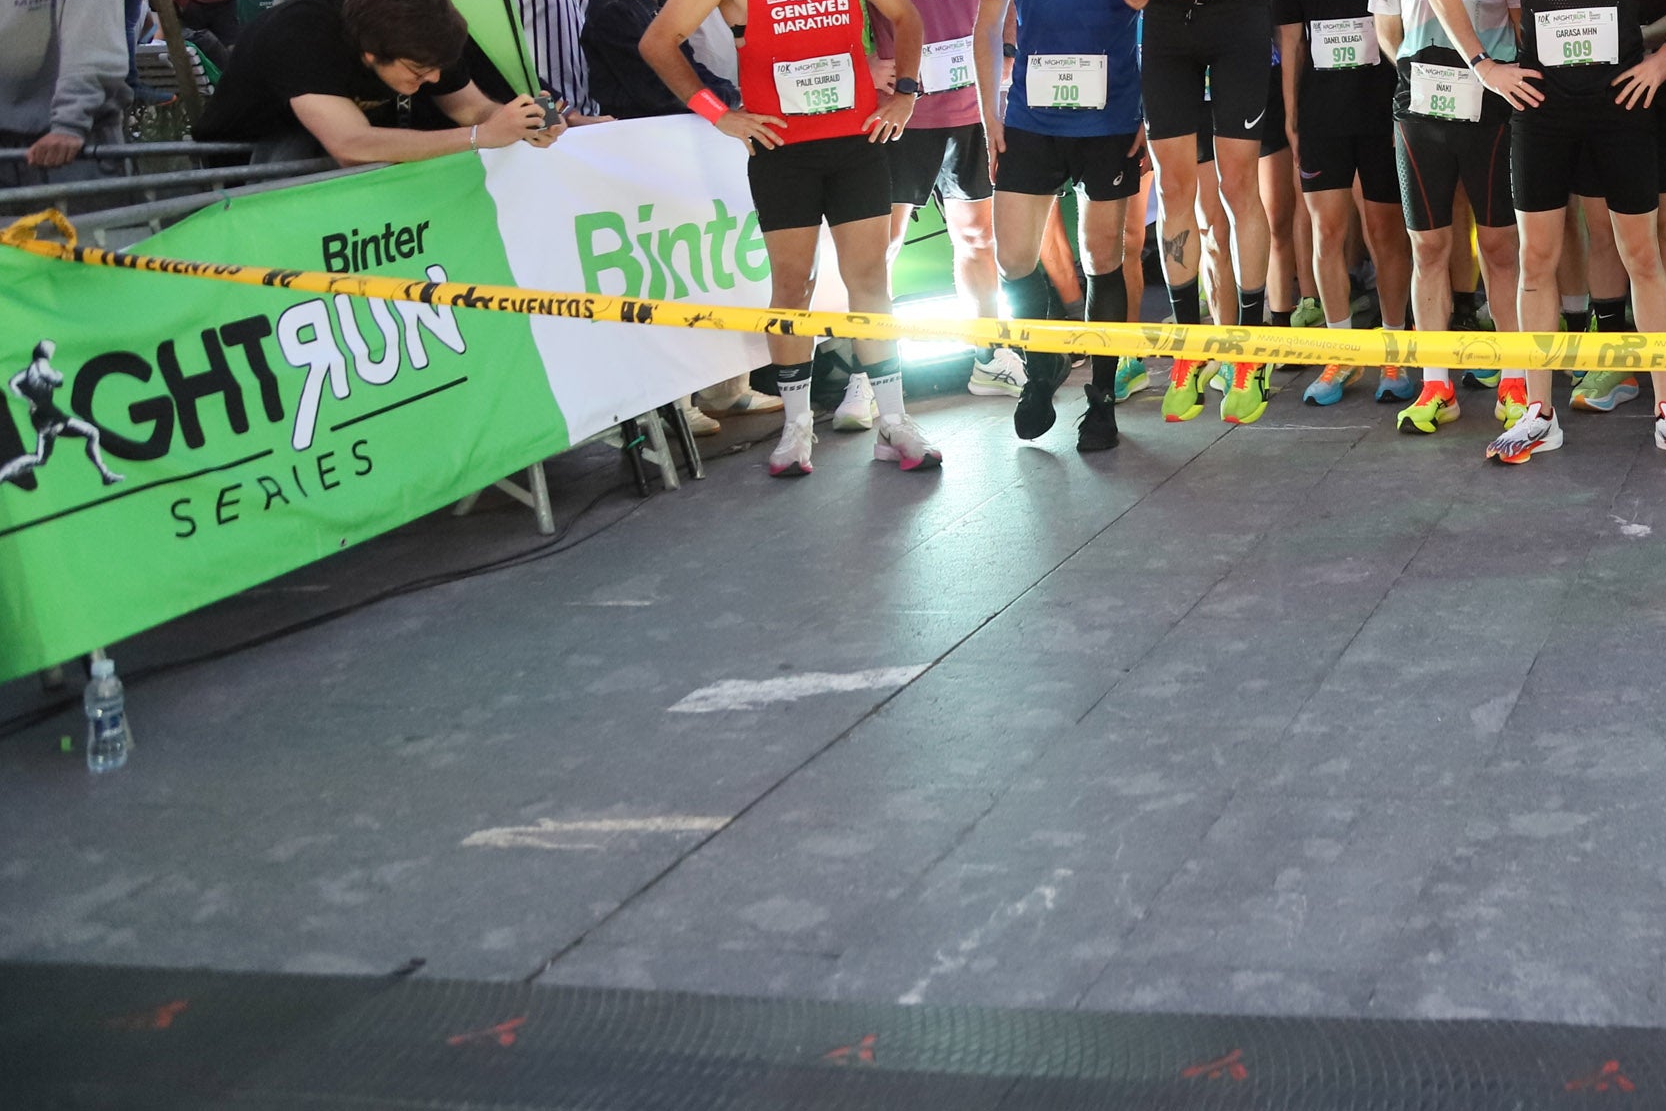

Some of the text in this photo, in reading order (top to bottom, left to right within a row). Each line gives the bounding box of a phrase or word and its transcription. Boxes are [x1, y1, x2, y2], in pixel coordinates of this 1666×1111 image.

[771, 0, 836, 20] GENÈVE
[773, 13, 850, 35] MARATHON
[1556, 29, 1581, 38] GARASA
[1332, 46, 1356, 62] 979
[1563, 40, 1592, 58] 609
[796, 73, 840, 87] PAUL GUIRAUD
[949, 65, 969, 83] 371
[1058, 73, 1073, 81] XABI
[803, 86, 839, 107] 1355
[1052, 85, 1079, 101] 700
[1430, 94, 1456, 112] 834
[322, 217, 431, 275] Binter
[574, 198, 773, 322] Binte
[171, 439, 374, 539] SERIES
